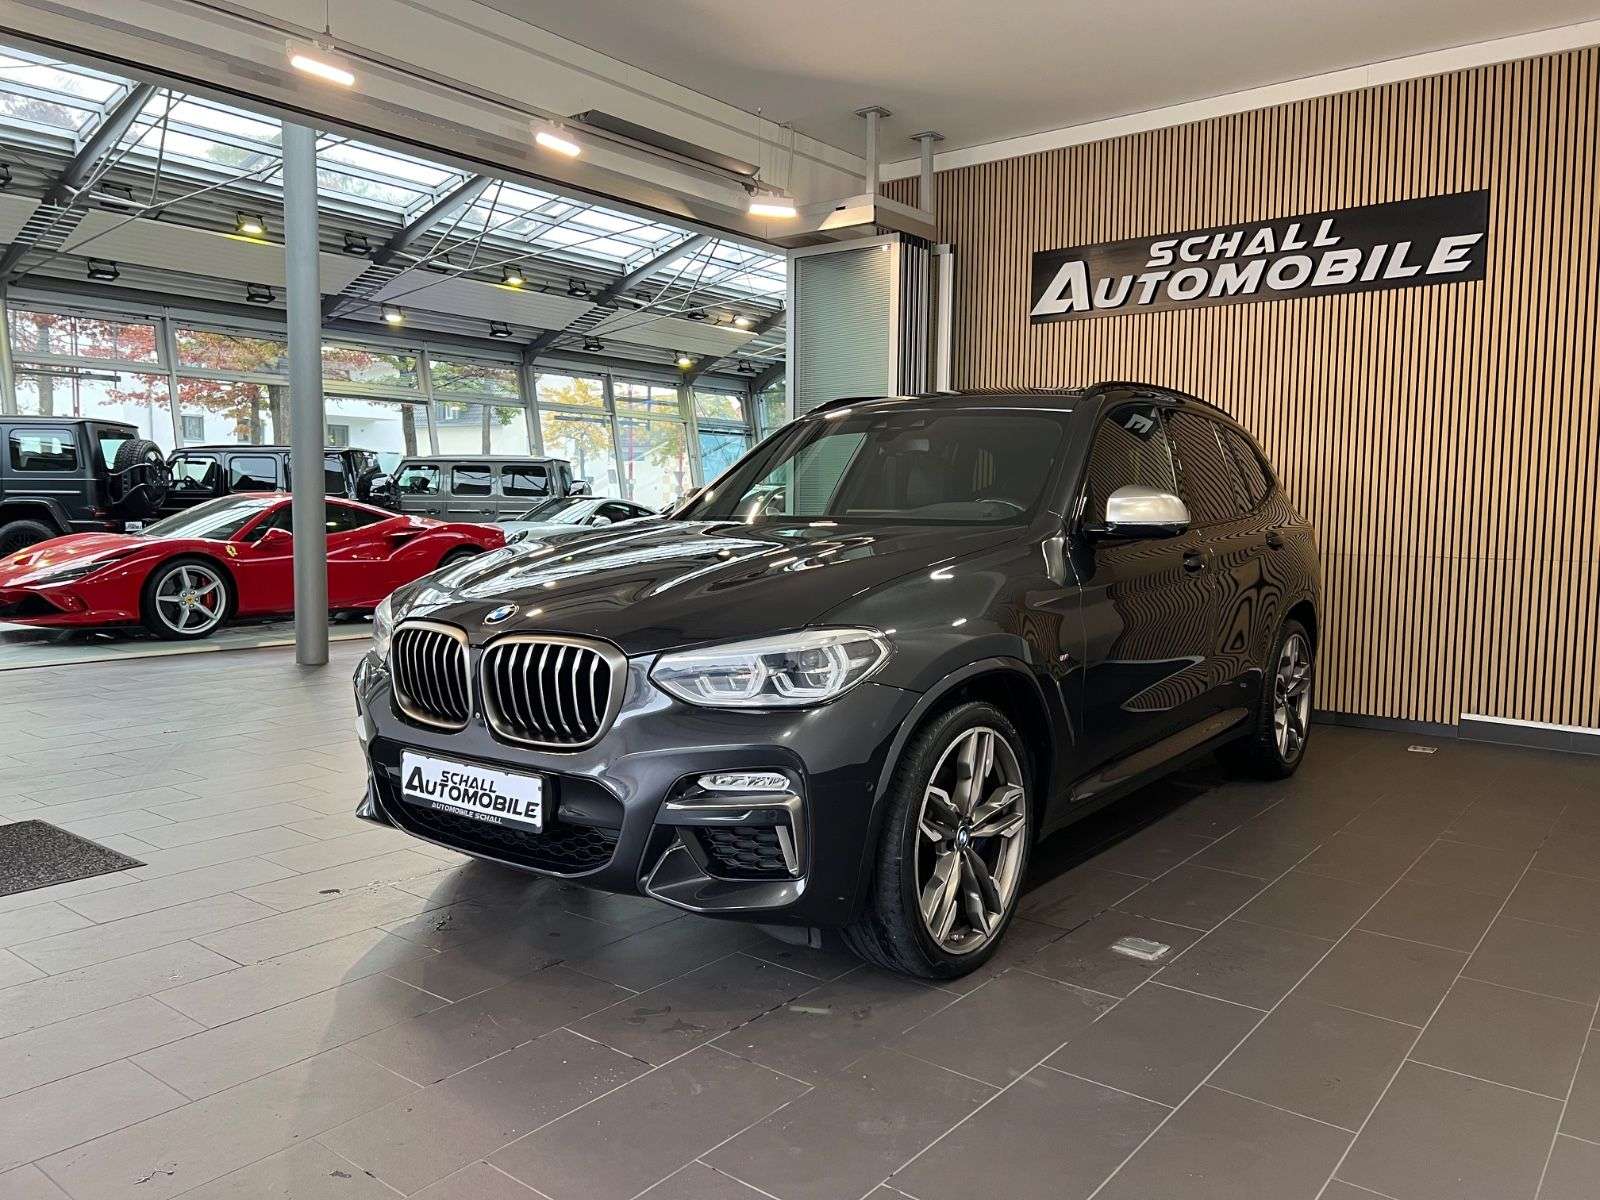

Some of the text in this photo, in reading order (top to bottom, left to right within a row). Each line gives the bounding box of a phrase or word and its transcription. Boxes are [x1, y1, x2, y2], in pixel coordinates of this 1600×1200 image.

[1145, 218, 1343, 268] SCHALL
[1030, 232, 1485, 317] AUTOMOBILE
[404, 766, 540, 818] AUTOMOBILE
[440, 770, 497, 793] SCHALL
[431, 801, 503, 824] AUTOMOBILE SCHALL
